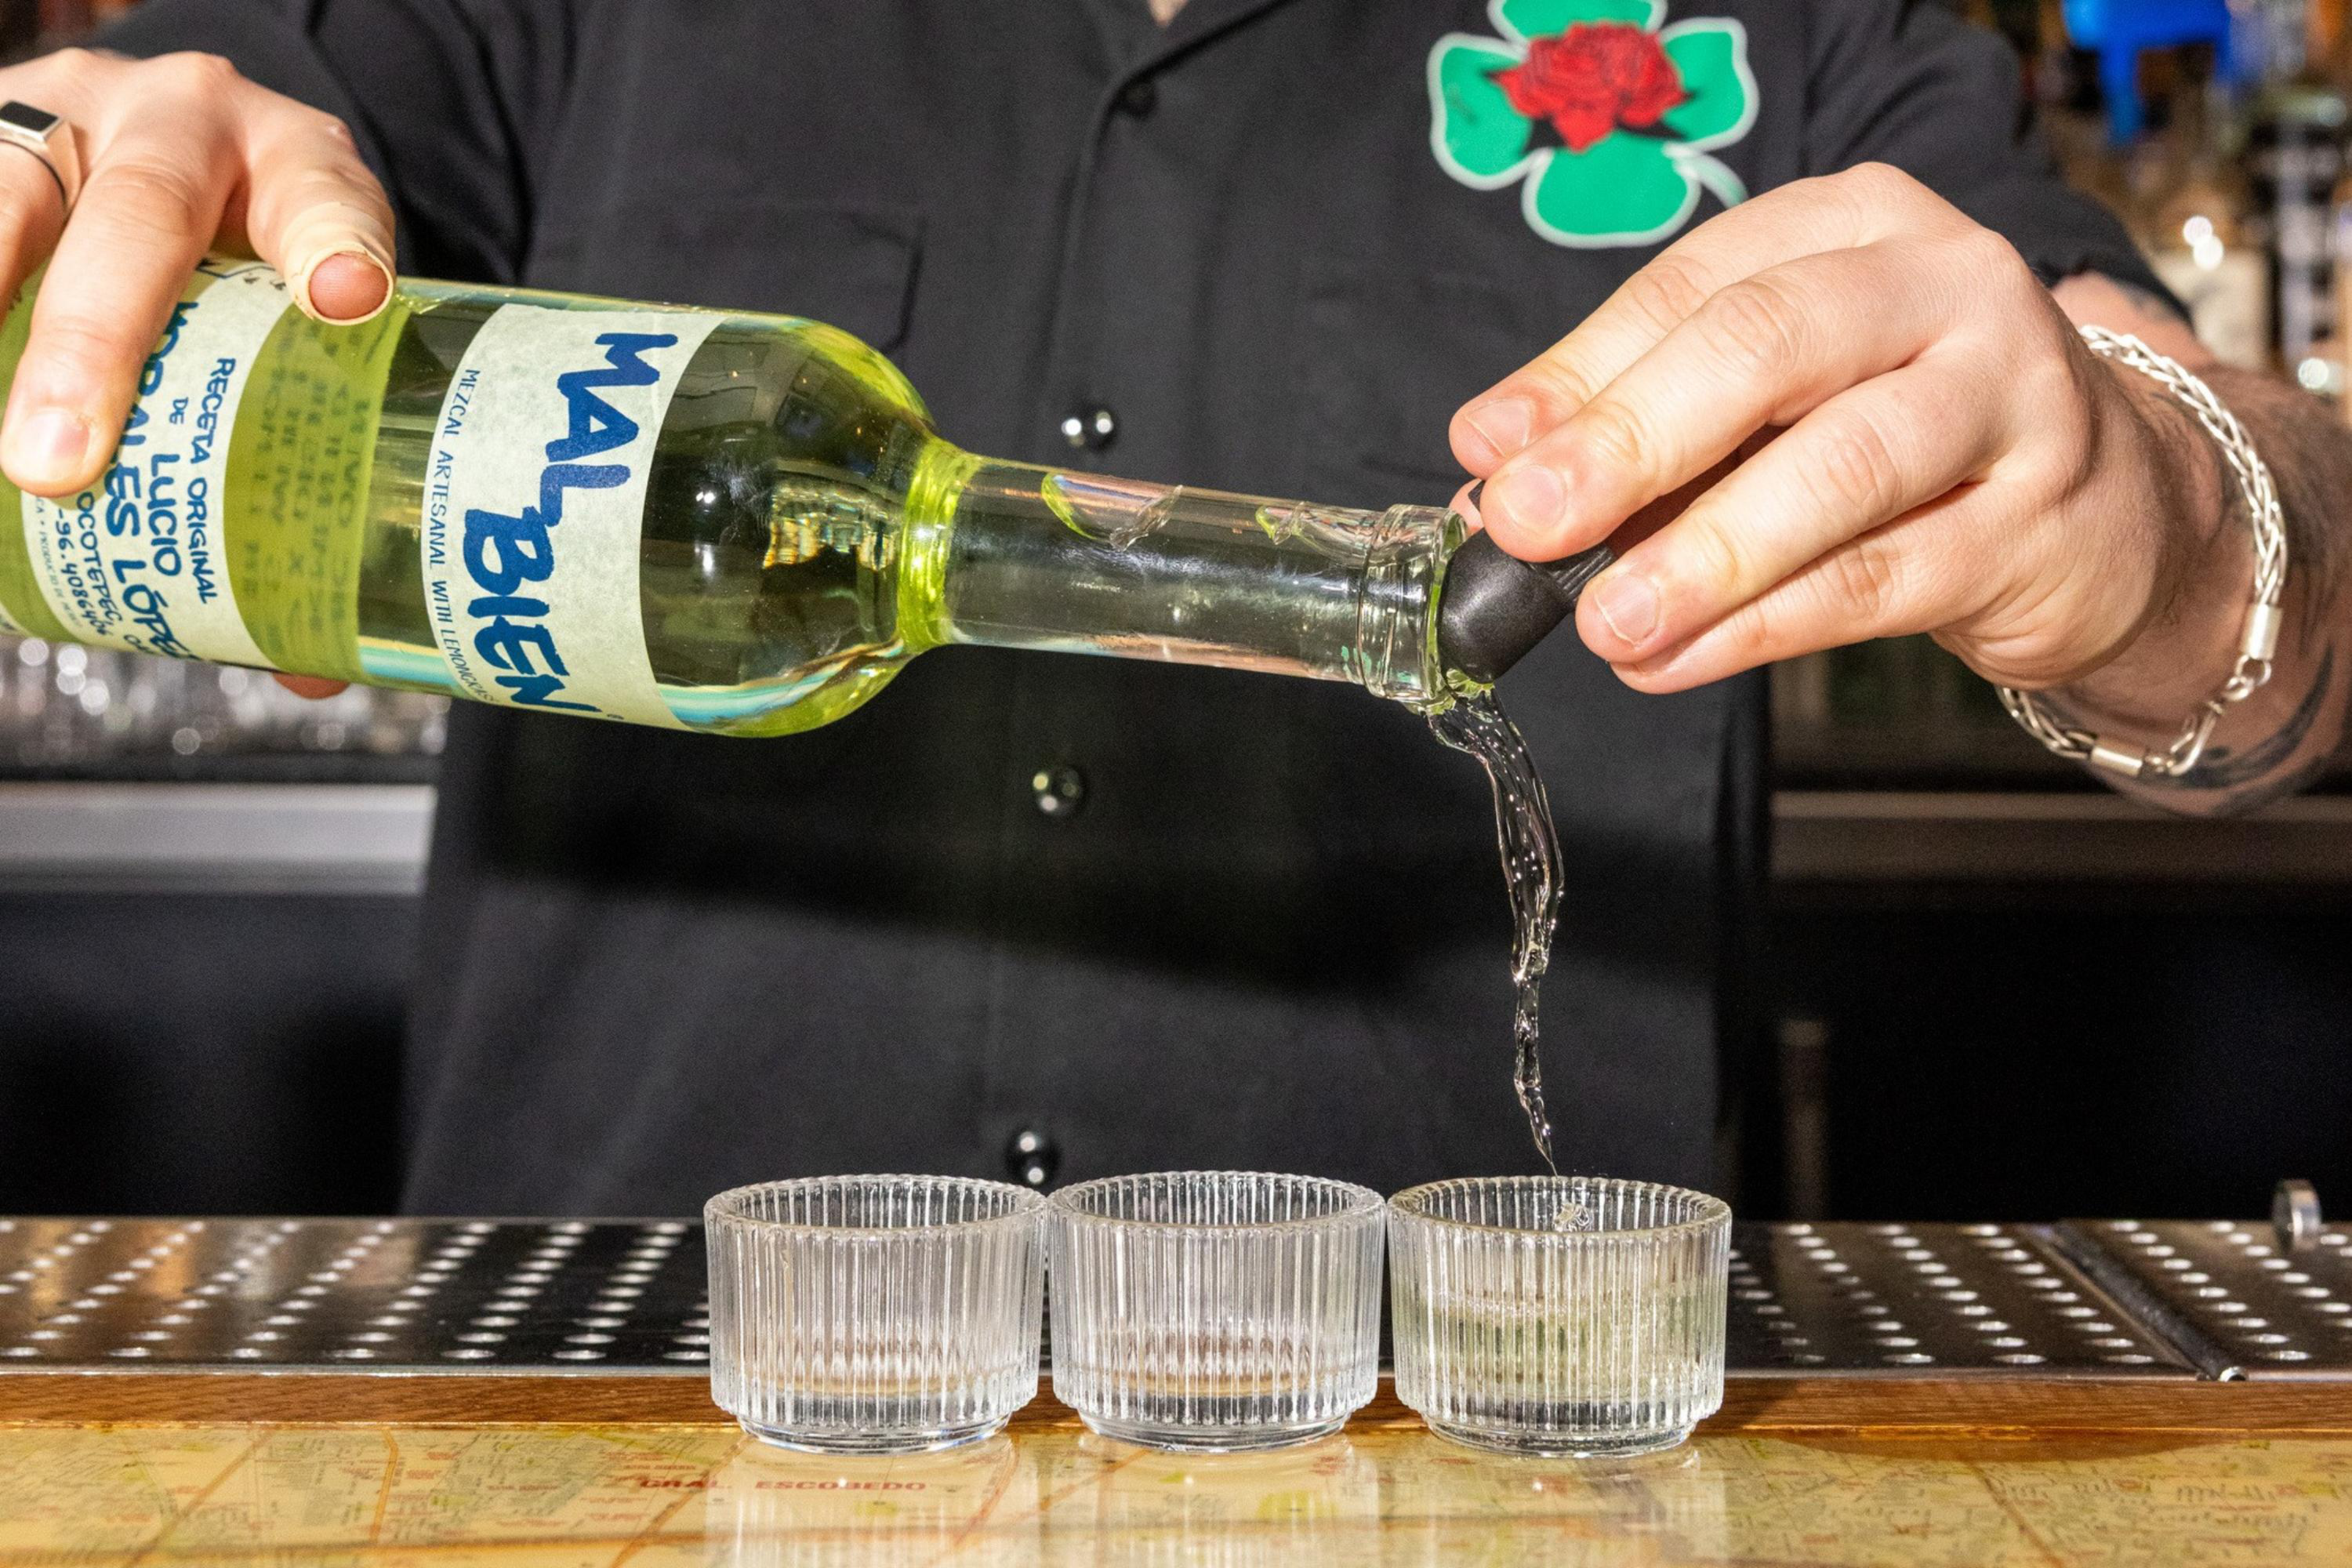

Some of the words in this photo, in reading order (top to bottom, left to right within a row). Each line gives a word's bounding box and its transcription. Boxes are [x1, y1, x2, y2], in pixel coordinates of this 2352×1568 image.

[168, 397, 189, 424] DE
[190, 358, 236, 464] RECETA
[442, 369, 481, 439] MEZCAL
[539, 333, 679, 527] MAL
[147, 453, 182, 576] LUCIO
[186, 477, 218, 605] ORIGINAL
[429, 450, 454, 570] ARTESANAL
[431, 580, 453, 623] WITH
[462, 506, 603, 713] BIEN
[754, 1480, 927, 1491] ESCOBEDO
